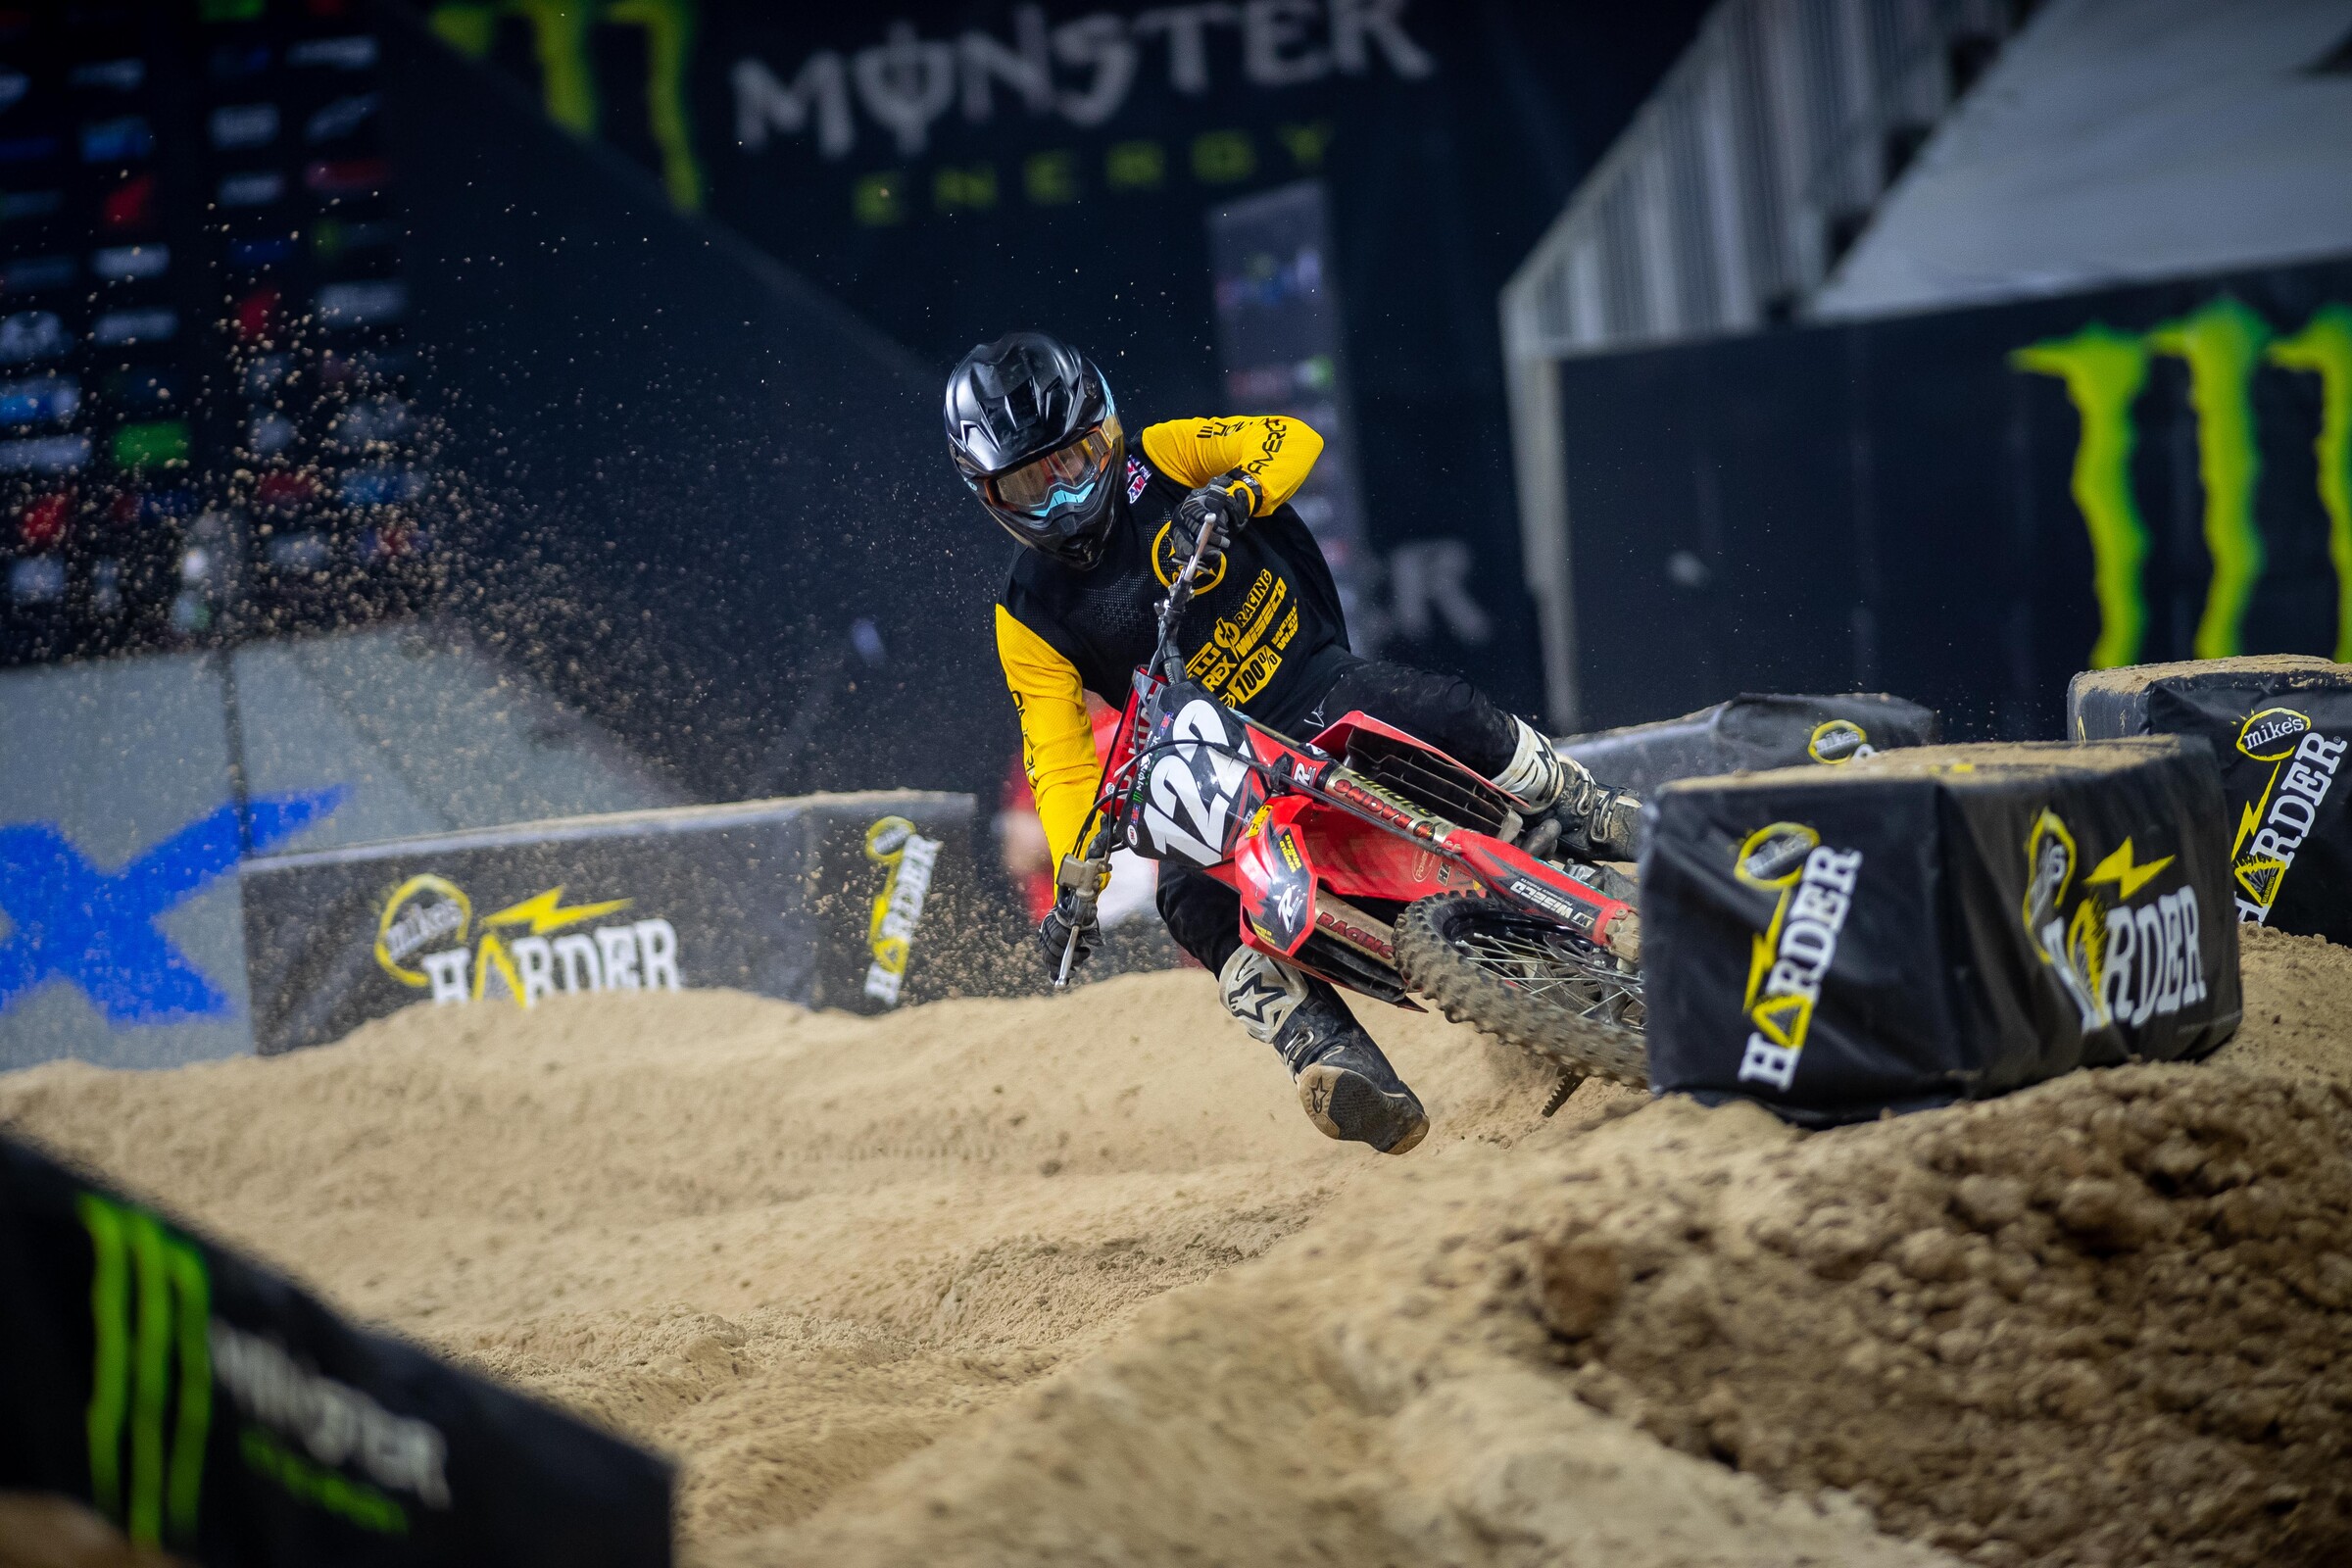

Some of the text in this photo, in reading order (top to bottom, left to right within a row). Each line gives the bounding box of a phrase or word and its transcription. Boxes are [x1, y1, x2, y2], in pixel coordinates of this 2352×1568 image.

[733, 0, 1434, 155] MONSTER
[1234, 568, 1272, 628] RACING
[1235, 647, 1277, 699] 100%
[2244, 716, 2304, 750] mike's
[1143, 699, 1251, 866] 122
[1334, 778, 1413, 830] RACING
[421, 918, 681, 1007] HARDER
[1316, 911, 1395, 960] RACING
[1739, 845, 1862, 1092] HARDER
